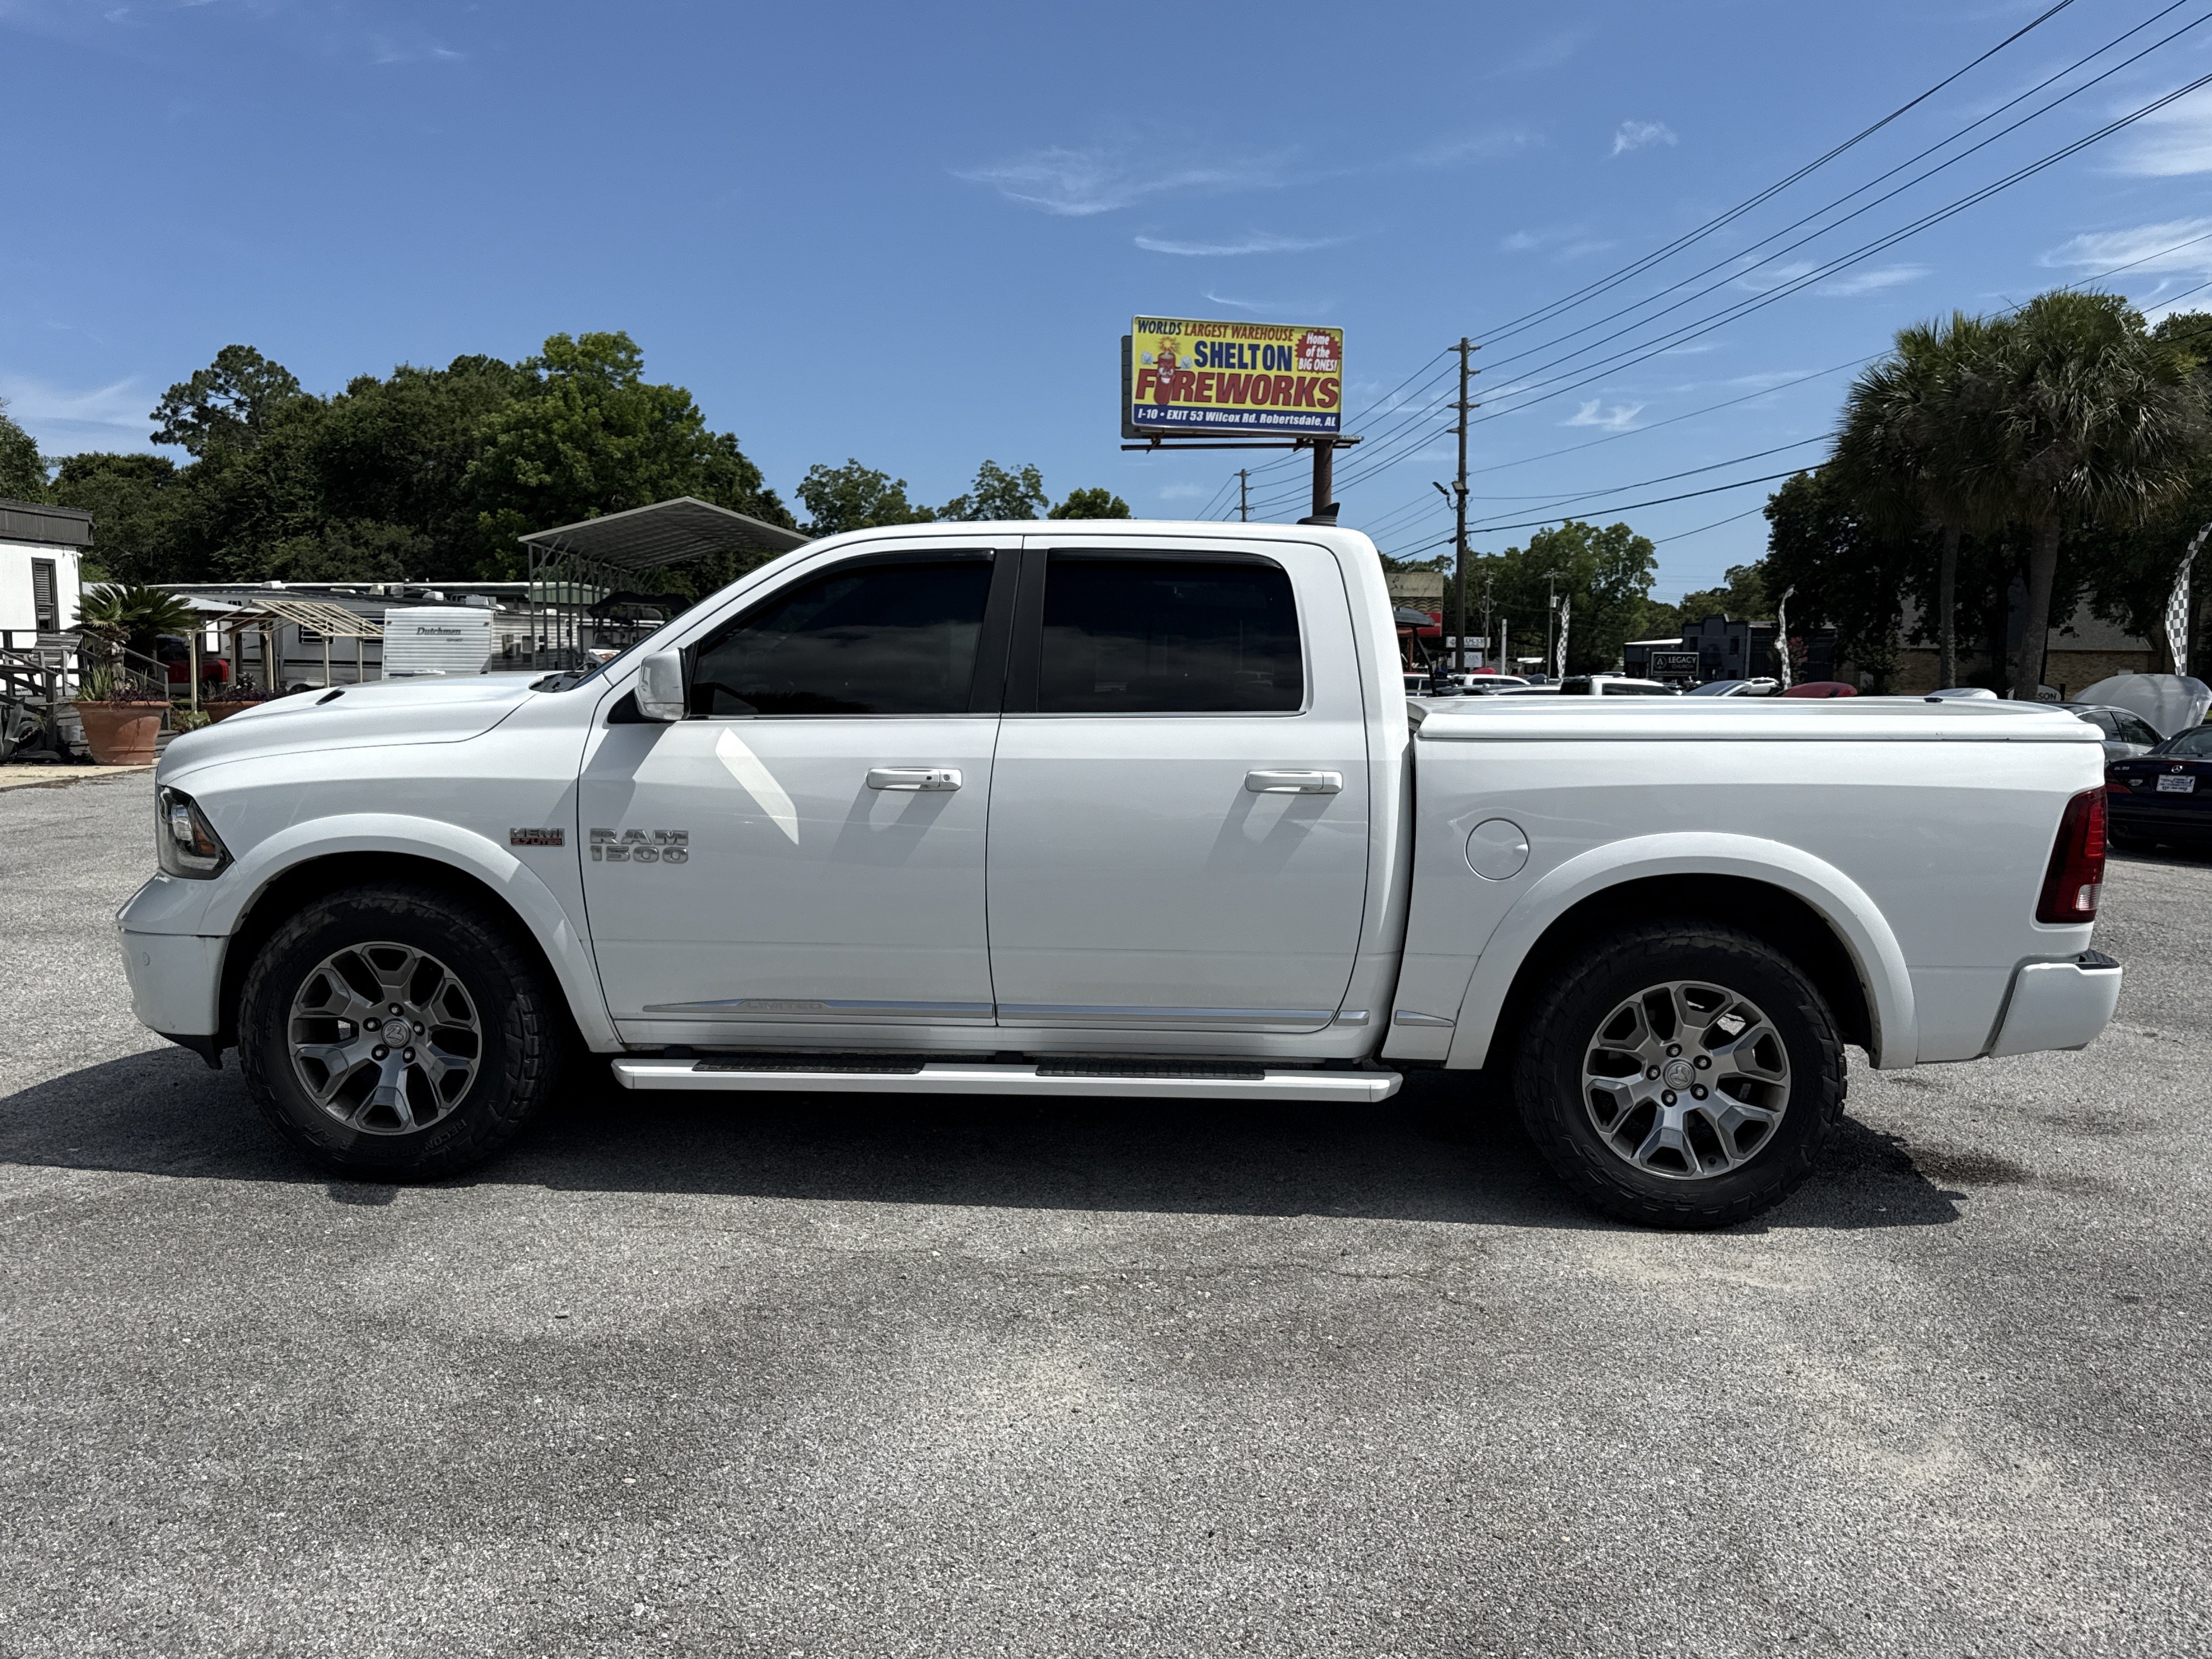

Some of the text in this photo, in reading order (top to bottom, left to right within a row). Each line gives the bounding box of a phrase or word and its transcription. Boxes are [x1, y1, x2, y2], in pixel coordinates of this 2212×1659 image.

[1138, 320, 1294, 341] WORLDS LARGEST WAREHOUSE
[1306, 332, 1330, 345] Home
[1194, 340, 1292, 371] SHELTON
[1306, 346, 1330, 358] of the
[1299, 358, 1338, 371] BIG ONES!
[1138, 408, 1336, 427] I-10 EXIT 53 Wilcox Rd. Robertsdale, AL
[510, 828, 565, 838] HEMI
[590, 828, 689, 845] RAM
[590, 845, 689, 864] 1500
[424, 1118, 466, 1152] RECON
